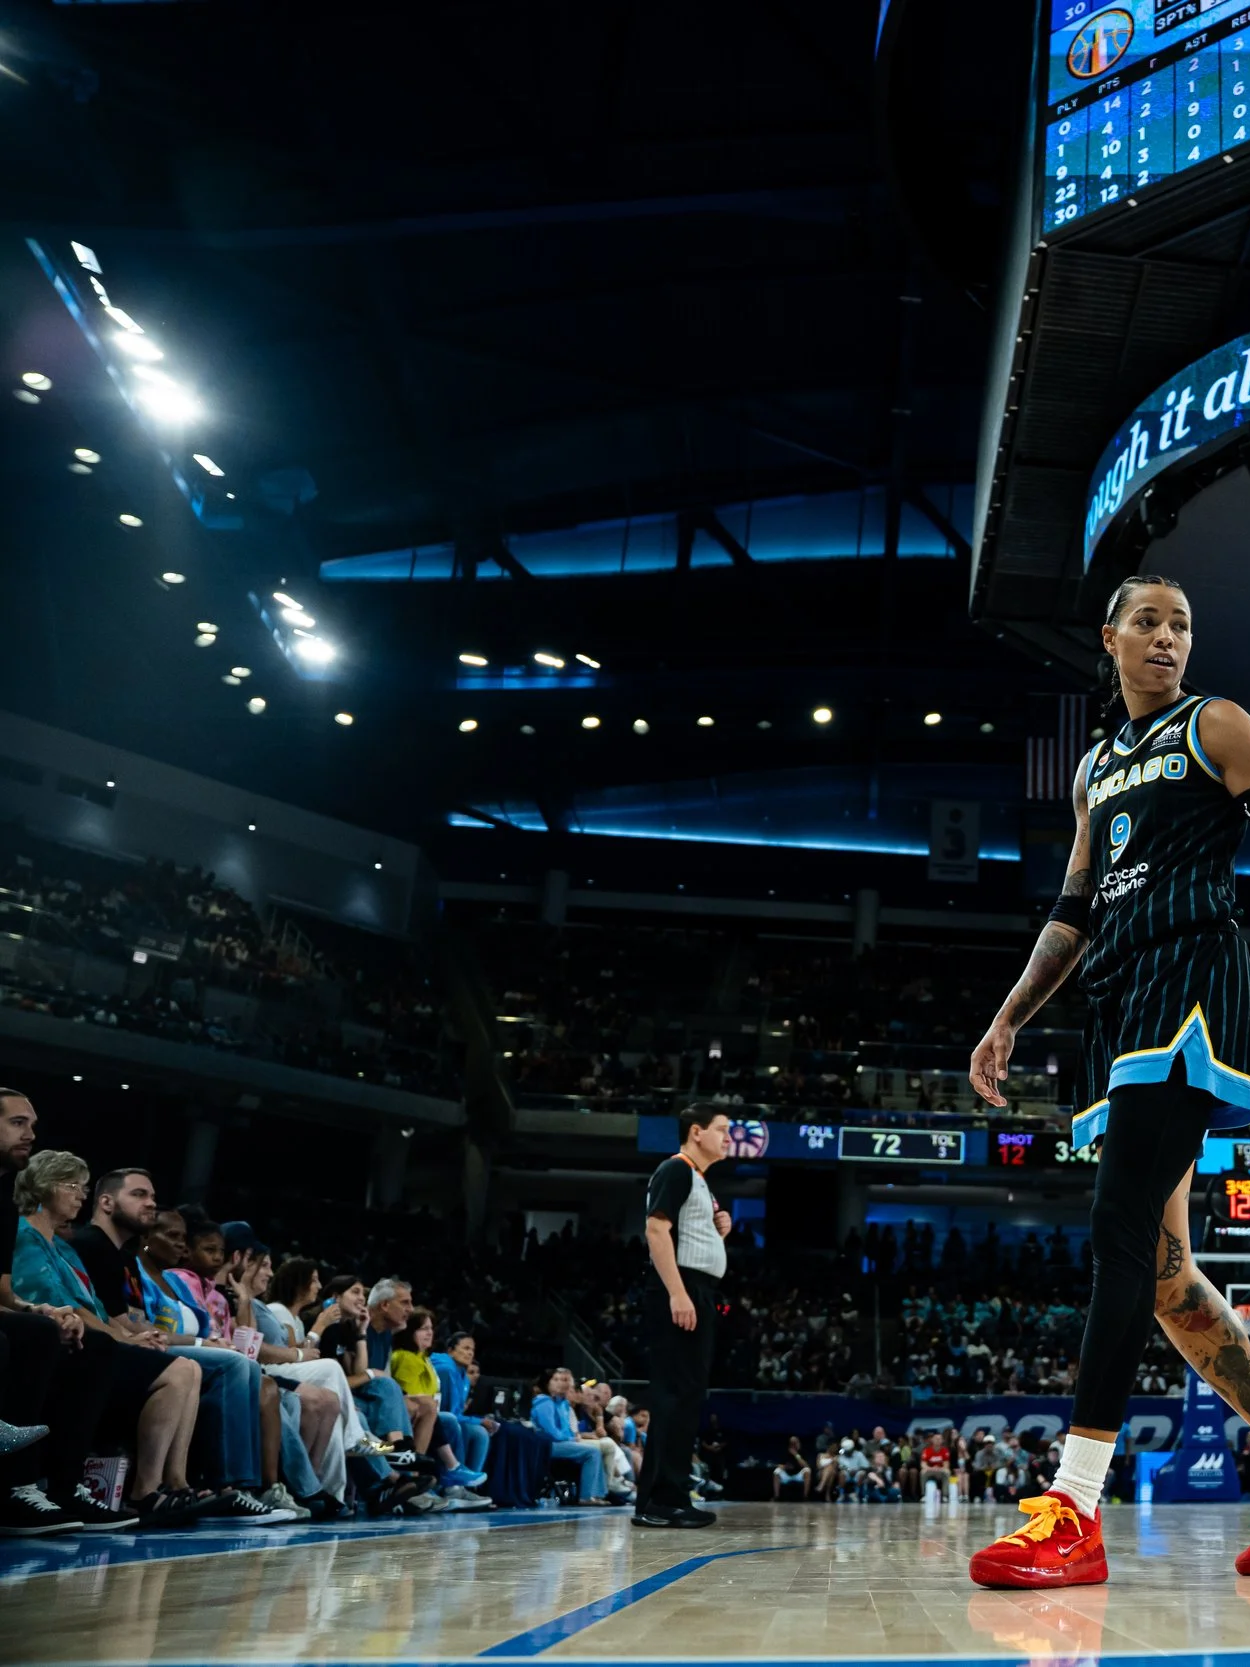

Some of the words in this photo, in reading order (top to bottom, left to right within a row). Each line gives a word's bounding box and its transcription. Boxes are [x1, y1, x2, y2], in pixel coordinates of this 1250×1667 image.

[1064, 4, 1086, 21] 30
[1058, 121, 1071, 136] 0
[1103, 95, 1121, 113] 14
[1141, 81, 1152, 96] 2
[1188, 57, 1199, 72] 2
[1233, 38, 1244, 51] 3
[1099, 77, 1120, 94] PTS
[1184, 33, 1208, 52] AST
[1056, 165, 1068, 180] 9
[1101, 140, 1121, 158] 10
[1138, 127, 1146, 140] 1
[1187, 102, 1199, 116] 9
[1233, 81, 1245, 96] 6
[1057, 144, 1065, 157] 1
[1102, 121, 1113, 134] 4
[1140, 103, 1151, 118] 2
[1188, 80, 1195, 93] 1
[1232, 60, 1240, 72] 1
[1054, 203, 1078, 225] 30
[1100, 184, 1119, 202] 12
[1137, 170, 1149, 185] 2
[1188, 146, 1200, 160] 4
[1233, 125, 1246, 140] 4
[1055, 182, 1077, 204] 22
[1101, 165, 1112, 179] 4
[1137, 148, 1149, 163] 3
[1188, 124, 1201, 139] 0
[1233, 104, 1247, 119] 0
[1159, 386, 1195, 450] it
[1110, 812, 1132, 864] 9
[799, 1125, 835, 1139] FOUL
[871, 1133, 901, 1156] 72
[931, 1134, 957, 1147] TOL
[938, 1146, 948, 1159] 3
[997, 1133, 1034, 1146] SHOT
[998, 1145, 1025, 1165] 12
